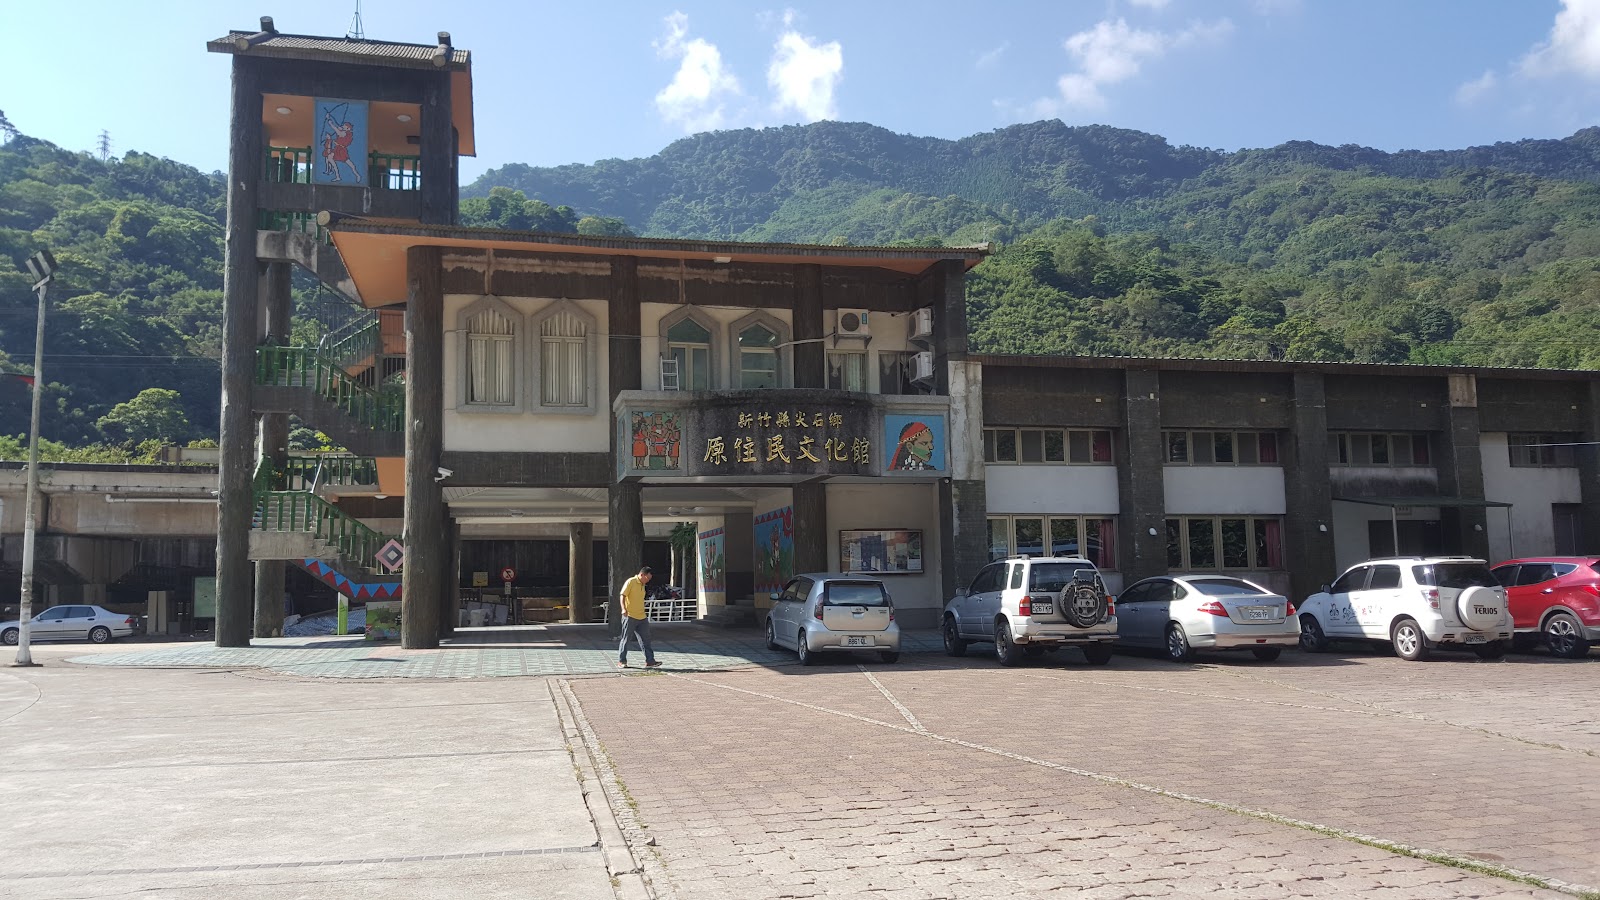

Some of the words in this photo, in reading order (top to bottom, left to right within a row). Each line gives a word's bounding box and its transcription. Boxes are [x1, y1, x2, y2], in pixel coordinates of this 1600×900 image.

[703, 434, 869, 465] 原住民文化館
[1474, 607, 1498, 615] TERIOS
